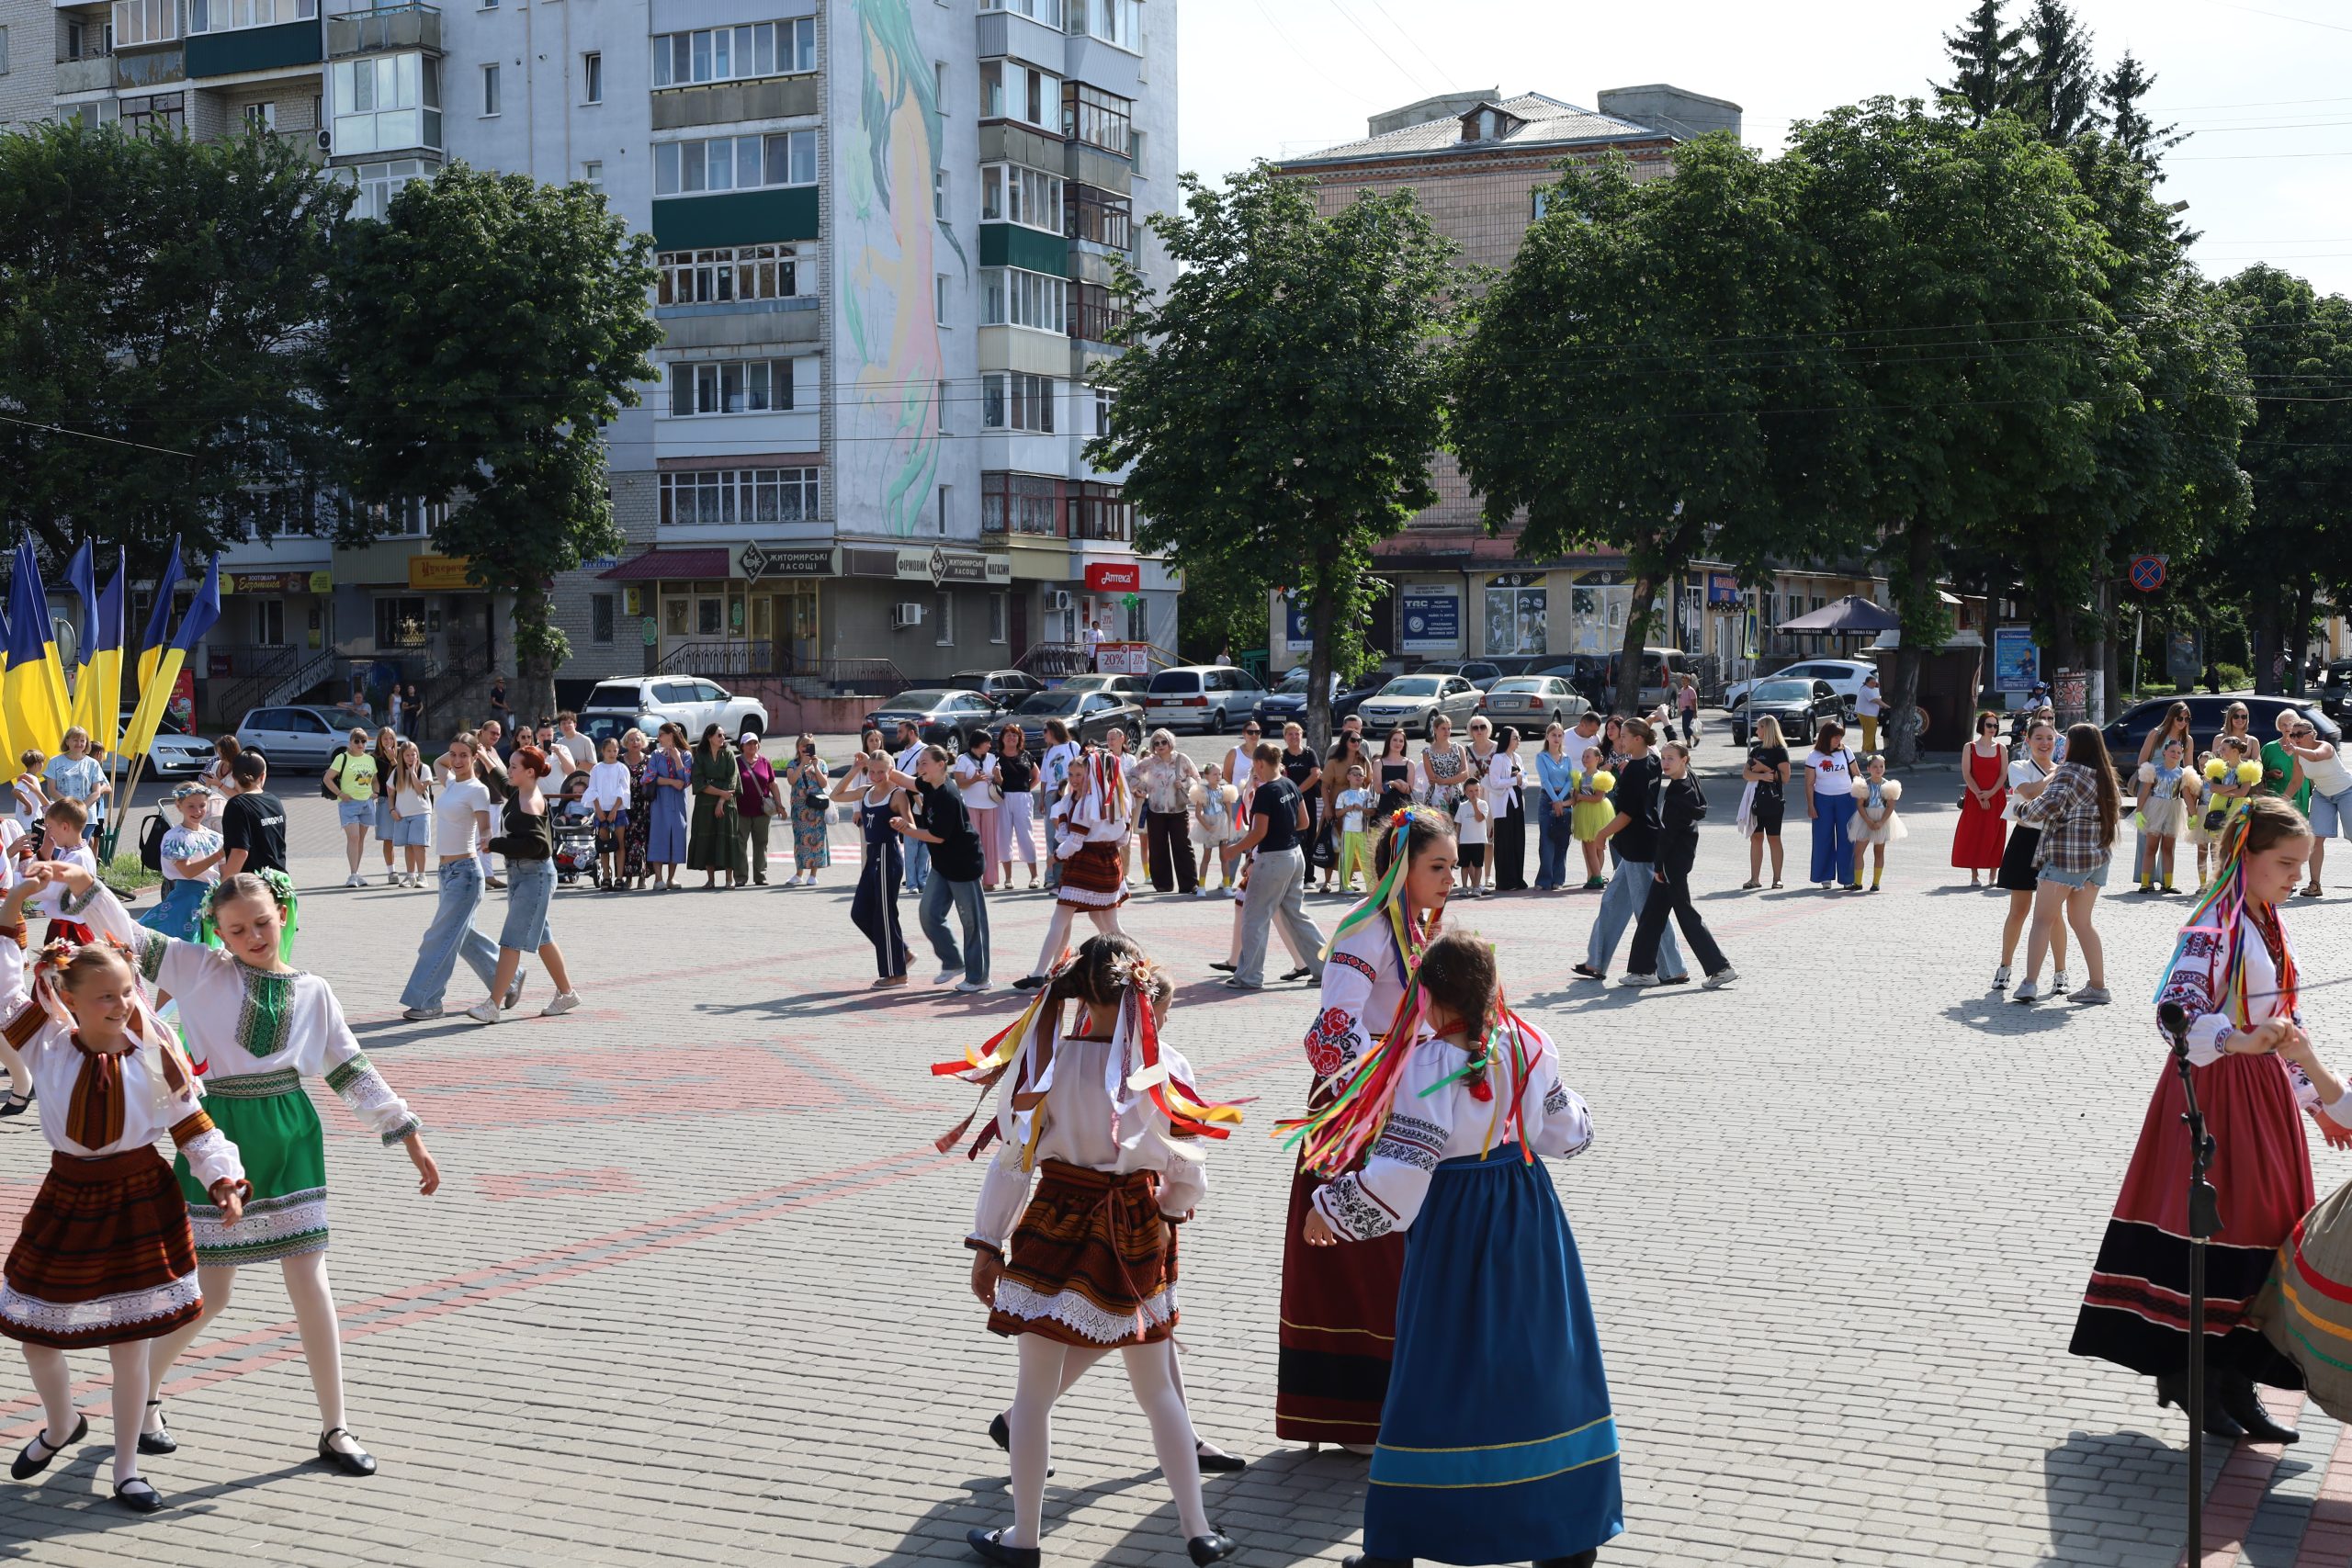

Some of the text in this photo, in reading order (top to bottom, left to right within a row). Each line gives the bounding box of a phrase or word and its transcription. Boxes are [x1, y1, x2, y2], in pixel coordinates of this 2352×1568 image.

[770, 553, 828, 561] ЖИТОМИРСЬКІ
[948, 558, 984, 568] ЖИТОМИРСЬКІ
[899, 558, 927, 571] ФІРМОВИЙ
[988, 563, 1010, 576] МАГАЗИН
[954, 568, 978, 576] ЛАСОЩІ
[1101, 571, 1131, 584] Аптека
[1102, 653, 1125, 665] -20%
[1132, 653, 1145, 665] -20%
